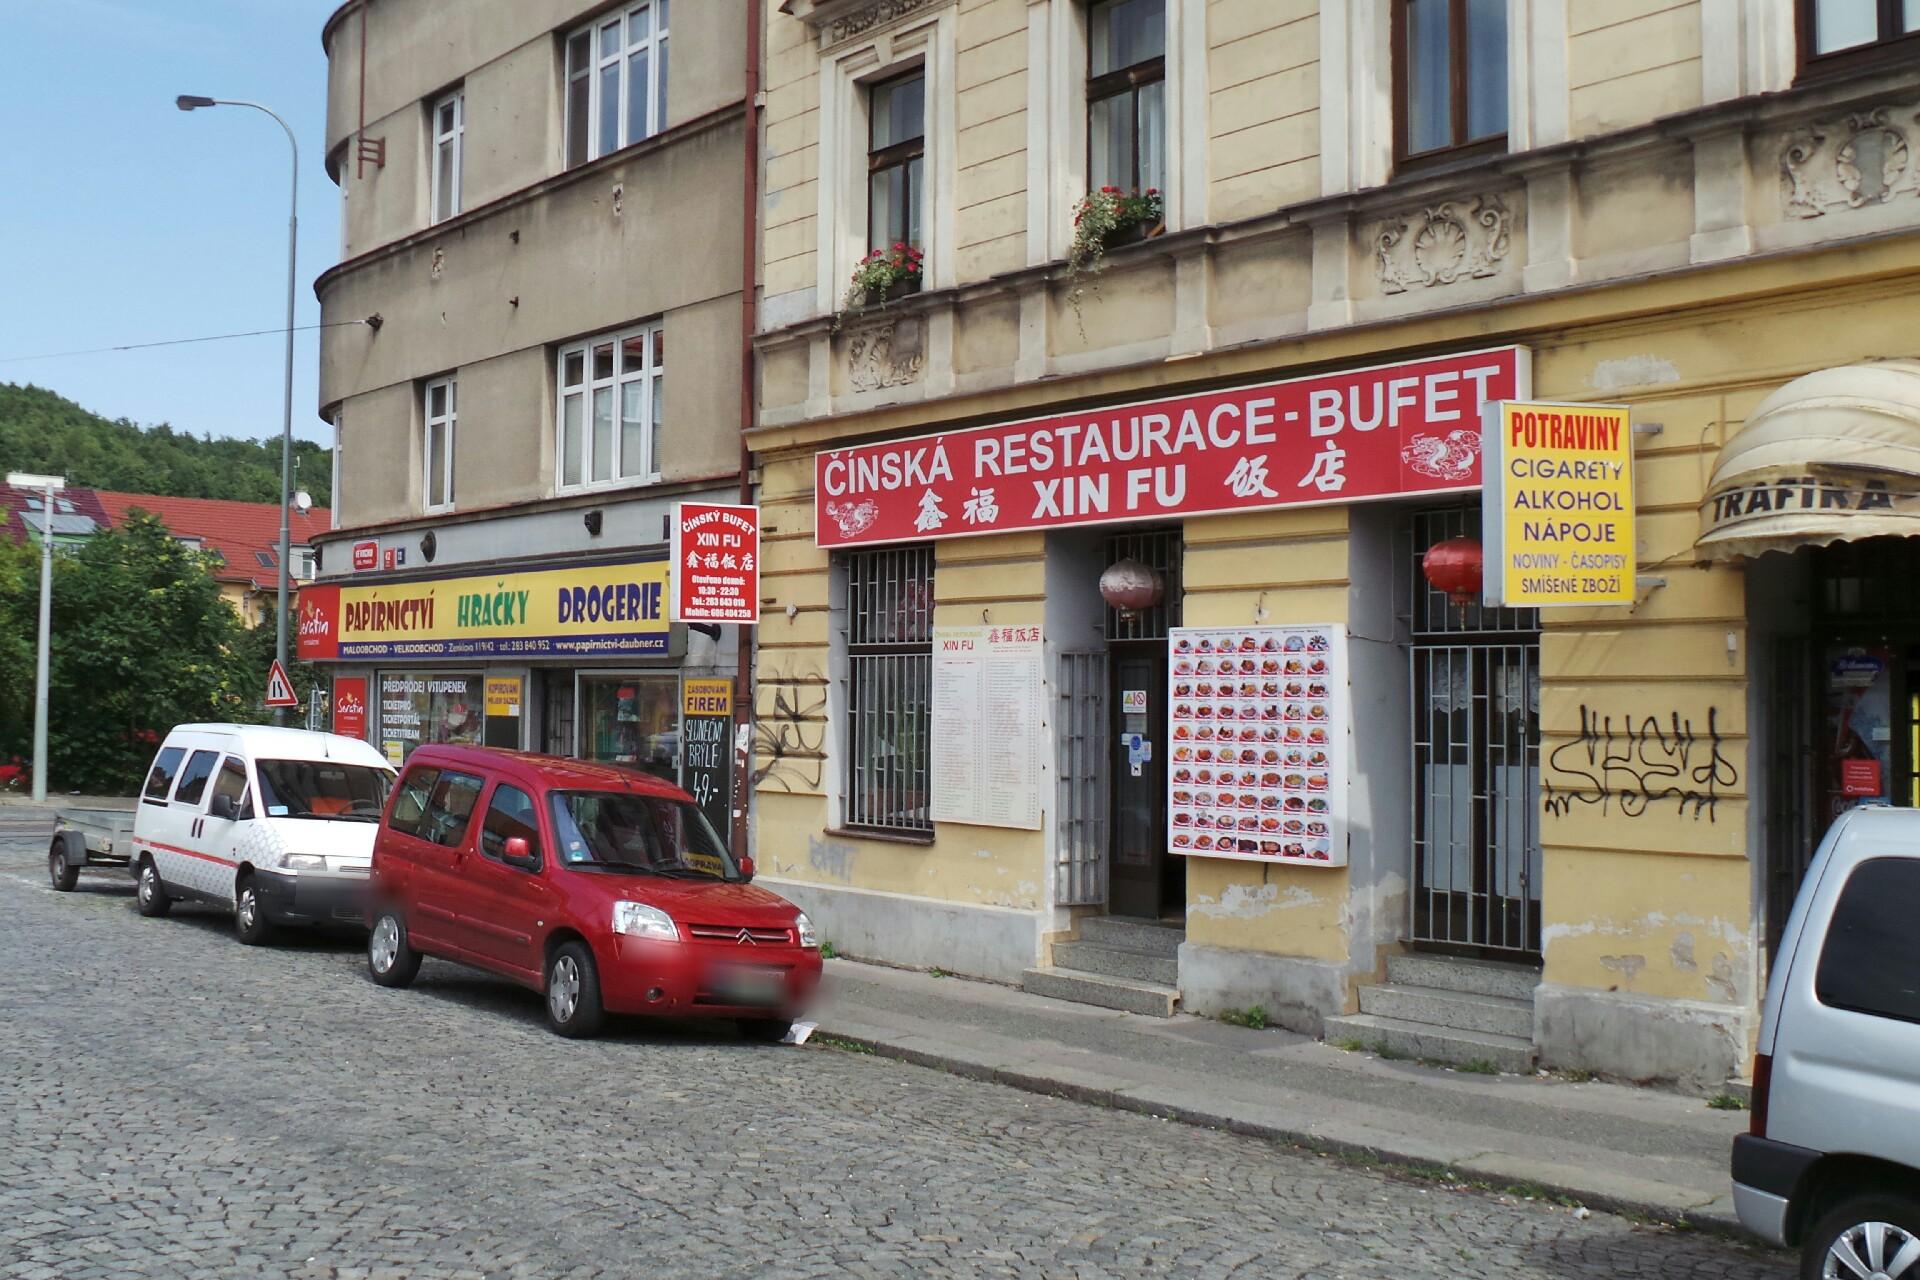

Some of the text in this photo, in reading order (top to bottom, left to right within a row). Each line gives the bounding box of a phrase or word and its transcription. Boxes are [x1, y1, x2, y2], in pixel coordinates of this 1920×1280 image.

[1511, 412, 1620, 451] POTRAVINY
[824, 437, 953, 496] ČÍNSKÁ
[1510, 458, 1623, 481] CIGARETY
[1032, 473, 1109, 519] XIN
[1126, 464, 1186, 509] FU
[1514, 490, 1623, 510] ALKOHOL
[1713, 477, 1893, 523] TRAFIKA
[682, 510, 755, 536] ČÍNSKÝ BUFET
[1524, 517, 1615, 542] NÁPOJE
[697, 532, 741, 548] XIN FU
[1513, 553, 1559, 569] NOVINY
[1571, 550, 1628, 569] ČASOPISY
[720, 587, 739, 596] 22:30
[1522, 574, 1621, 593] SMÍŠENÉ ZBOŽÍ
[345, 581, 662, 632] PAPÍRNICTVÍ HRAČKY DROGERIE
[343, 644, 388, 656] MALOOBCHOD
[393, 643, 444, 654] VELKOOBCHOD
[511, 640, 523, 651] 283
[538, 639, 550, 650] 952
[943, 639, 974, 650] XIN FU
[427, 681, 467, 694] VSTUPENEK
[337, 698, 363, 716] Serafin
[383, 700, 411, 711] TICKETPRO
[687, 697, 727, 712] FIREM
[383, 713, 421, 726] TICKETPORTÁL
[686, 717, 725, 742] SLUNEČNÍ
